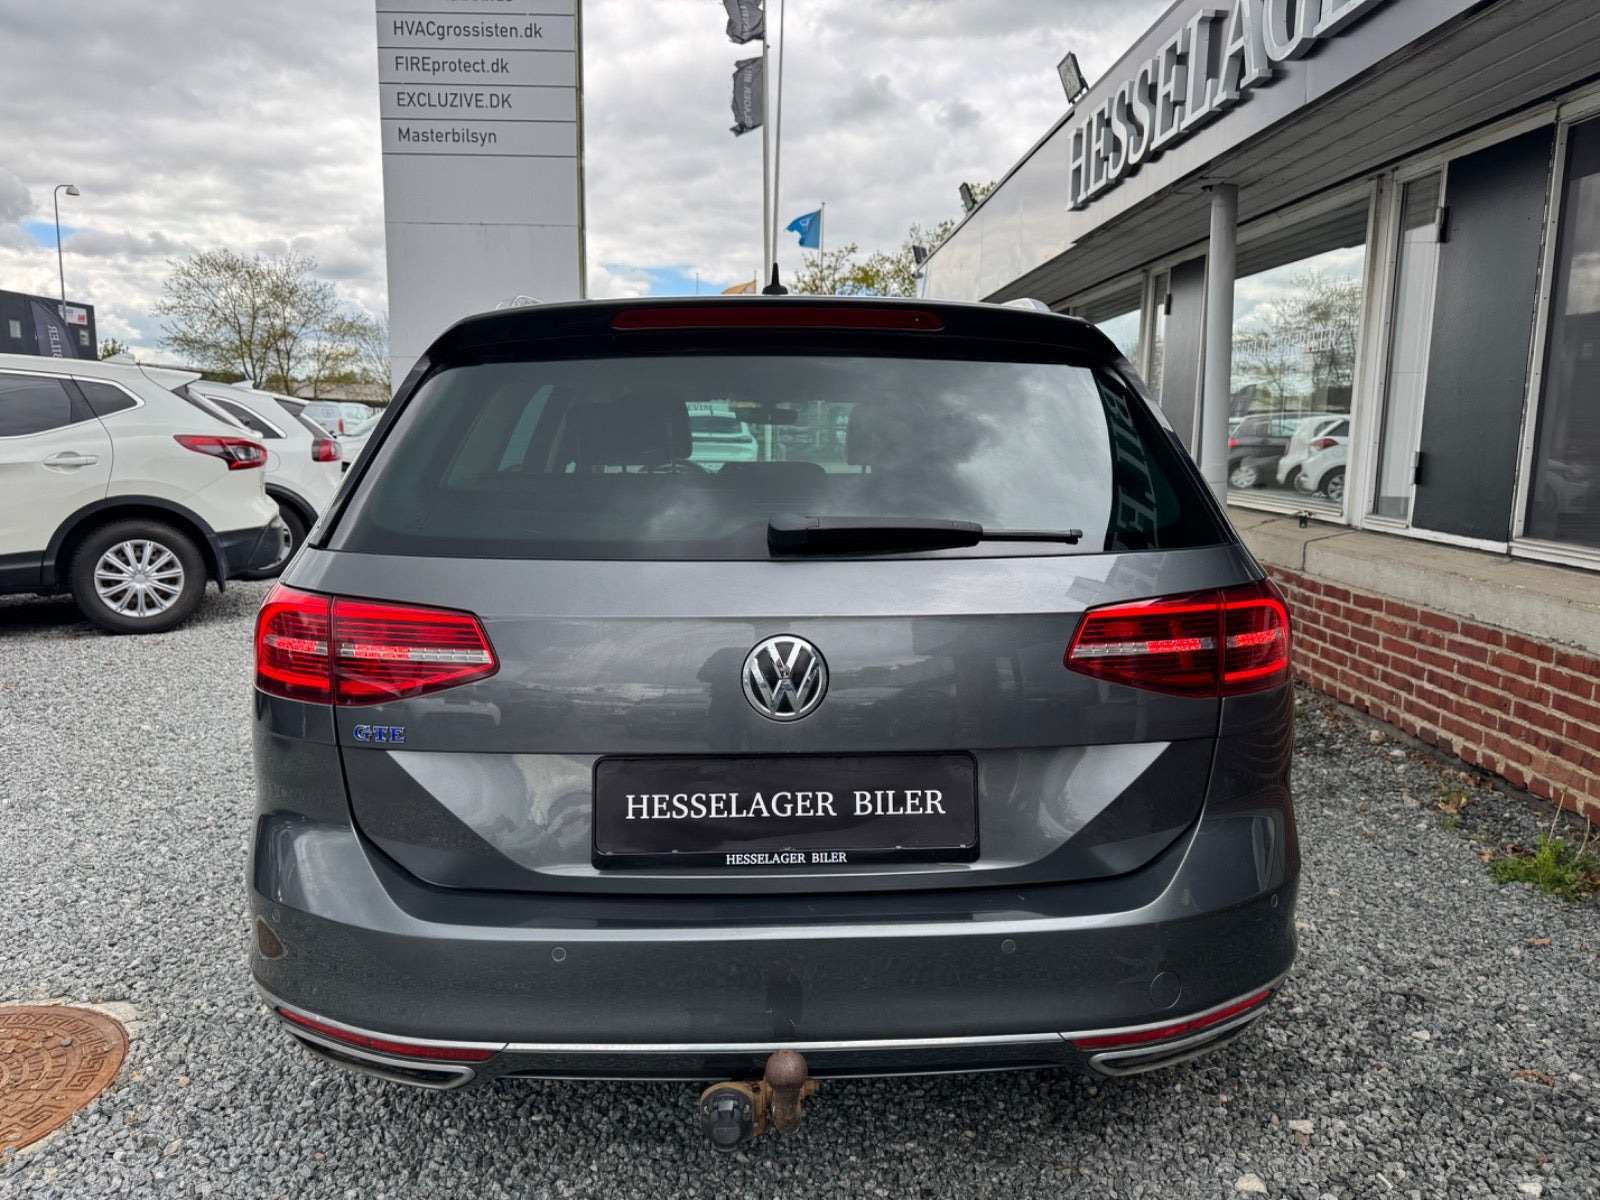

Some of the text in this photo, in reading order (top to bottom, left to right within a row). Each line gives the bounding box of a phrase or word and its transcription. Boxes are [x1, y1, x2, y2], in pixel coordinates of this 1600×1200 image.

[393, 20, 543, 40] HVACgrossisten.dk
[395, 56, 510, 75] FIREprotect.dk
[396, 91, 512, 109] EXCLUZIVE.DK
[1067, 0, 1386, 211] HESSELA
[398, 127, 497, 147] Masterbilsyn
[353, 724, 406, 743] GTE
[625, 789, 946, 820] HESSELAGER BILER
[725, 850, 848, 866] HESSELAGER BILER
